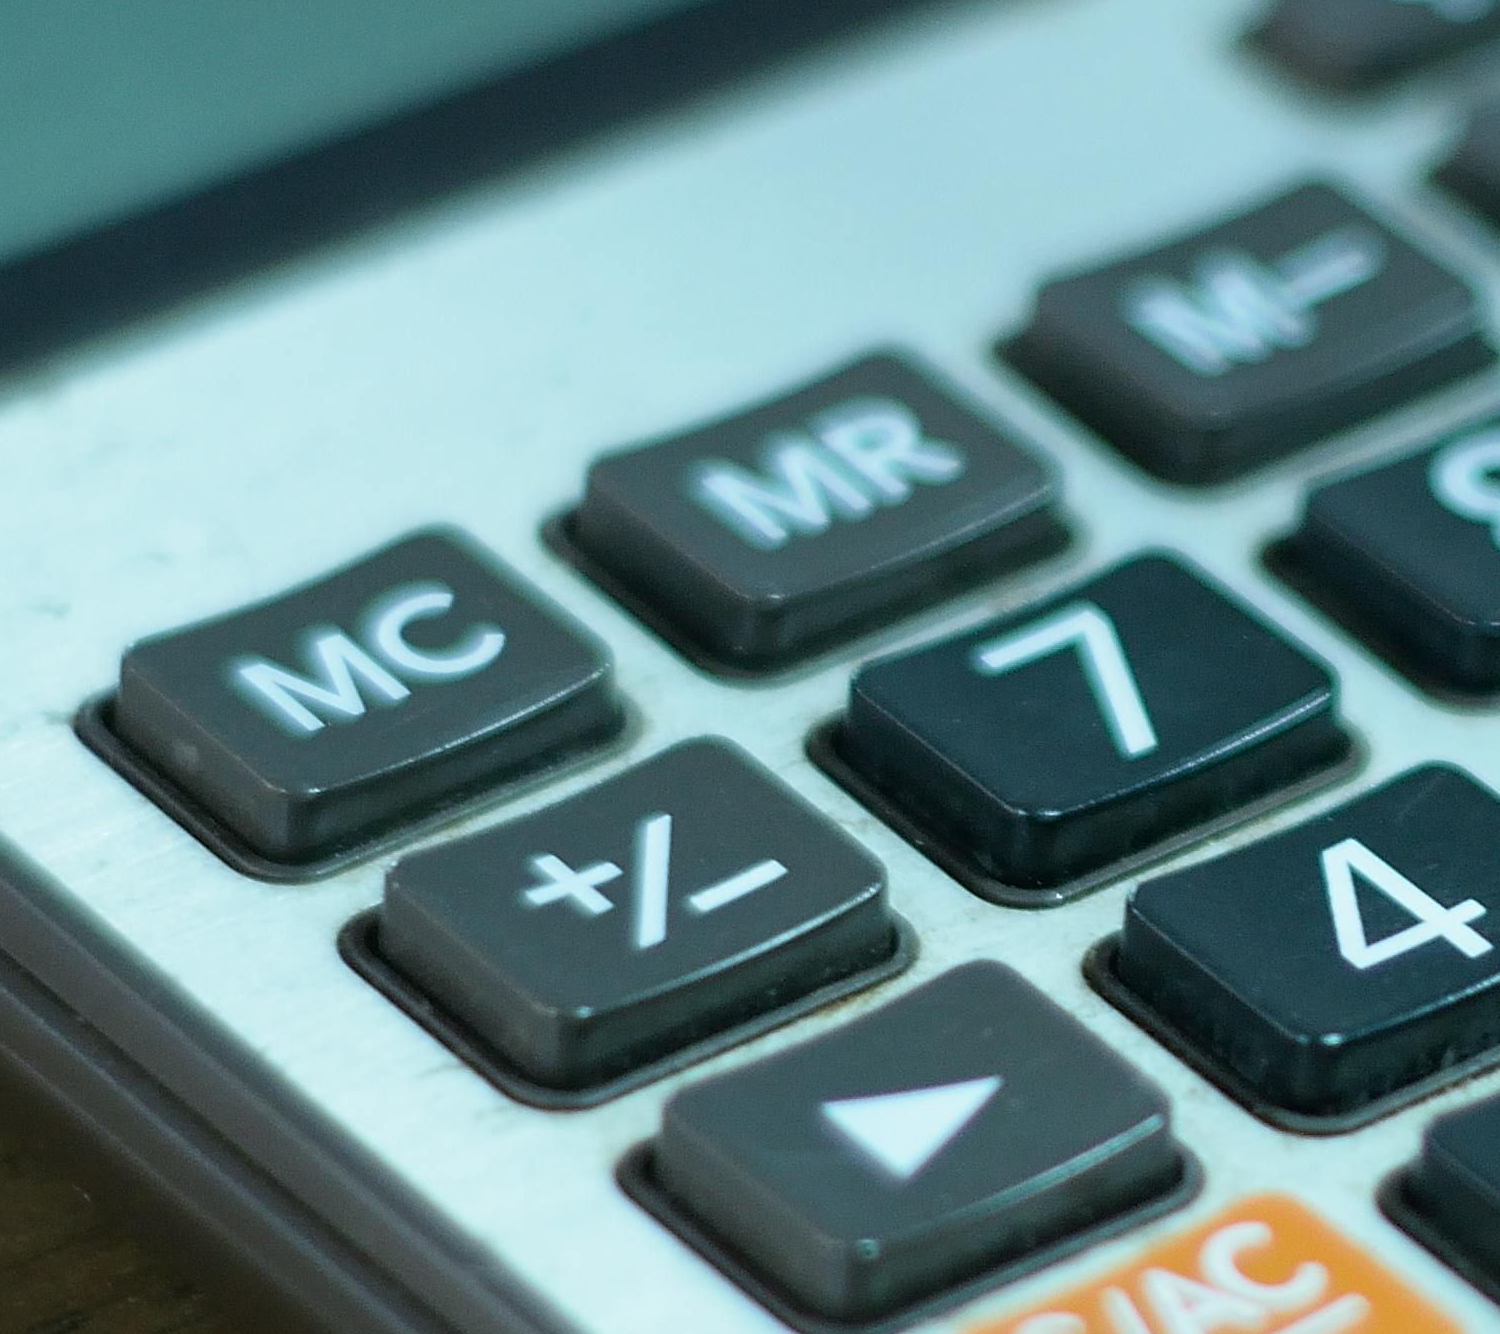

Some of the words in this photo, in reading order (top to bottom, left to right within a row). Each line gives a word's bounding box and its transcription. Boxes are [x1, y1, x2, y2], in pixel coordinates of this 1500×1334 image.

[700, 395, 965, 549] MR
[233, 580, 508, 734] MC
[975, 605, 1160, 759] 7
[1318, 835, 1492, 972] 4
